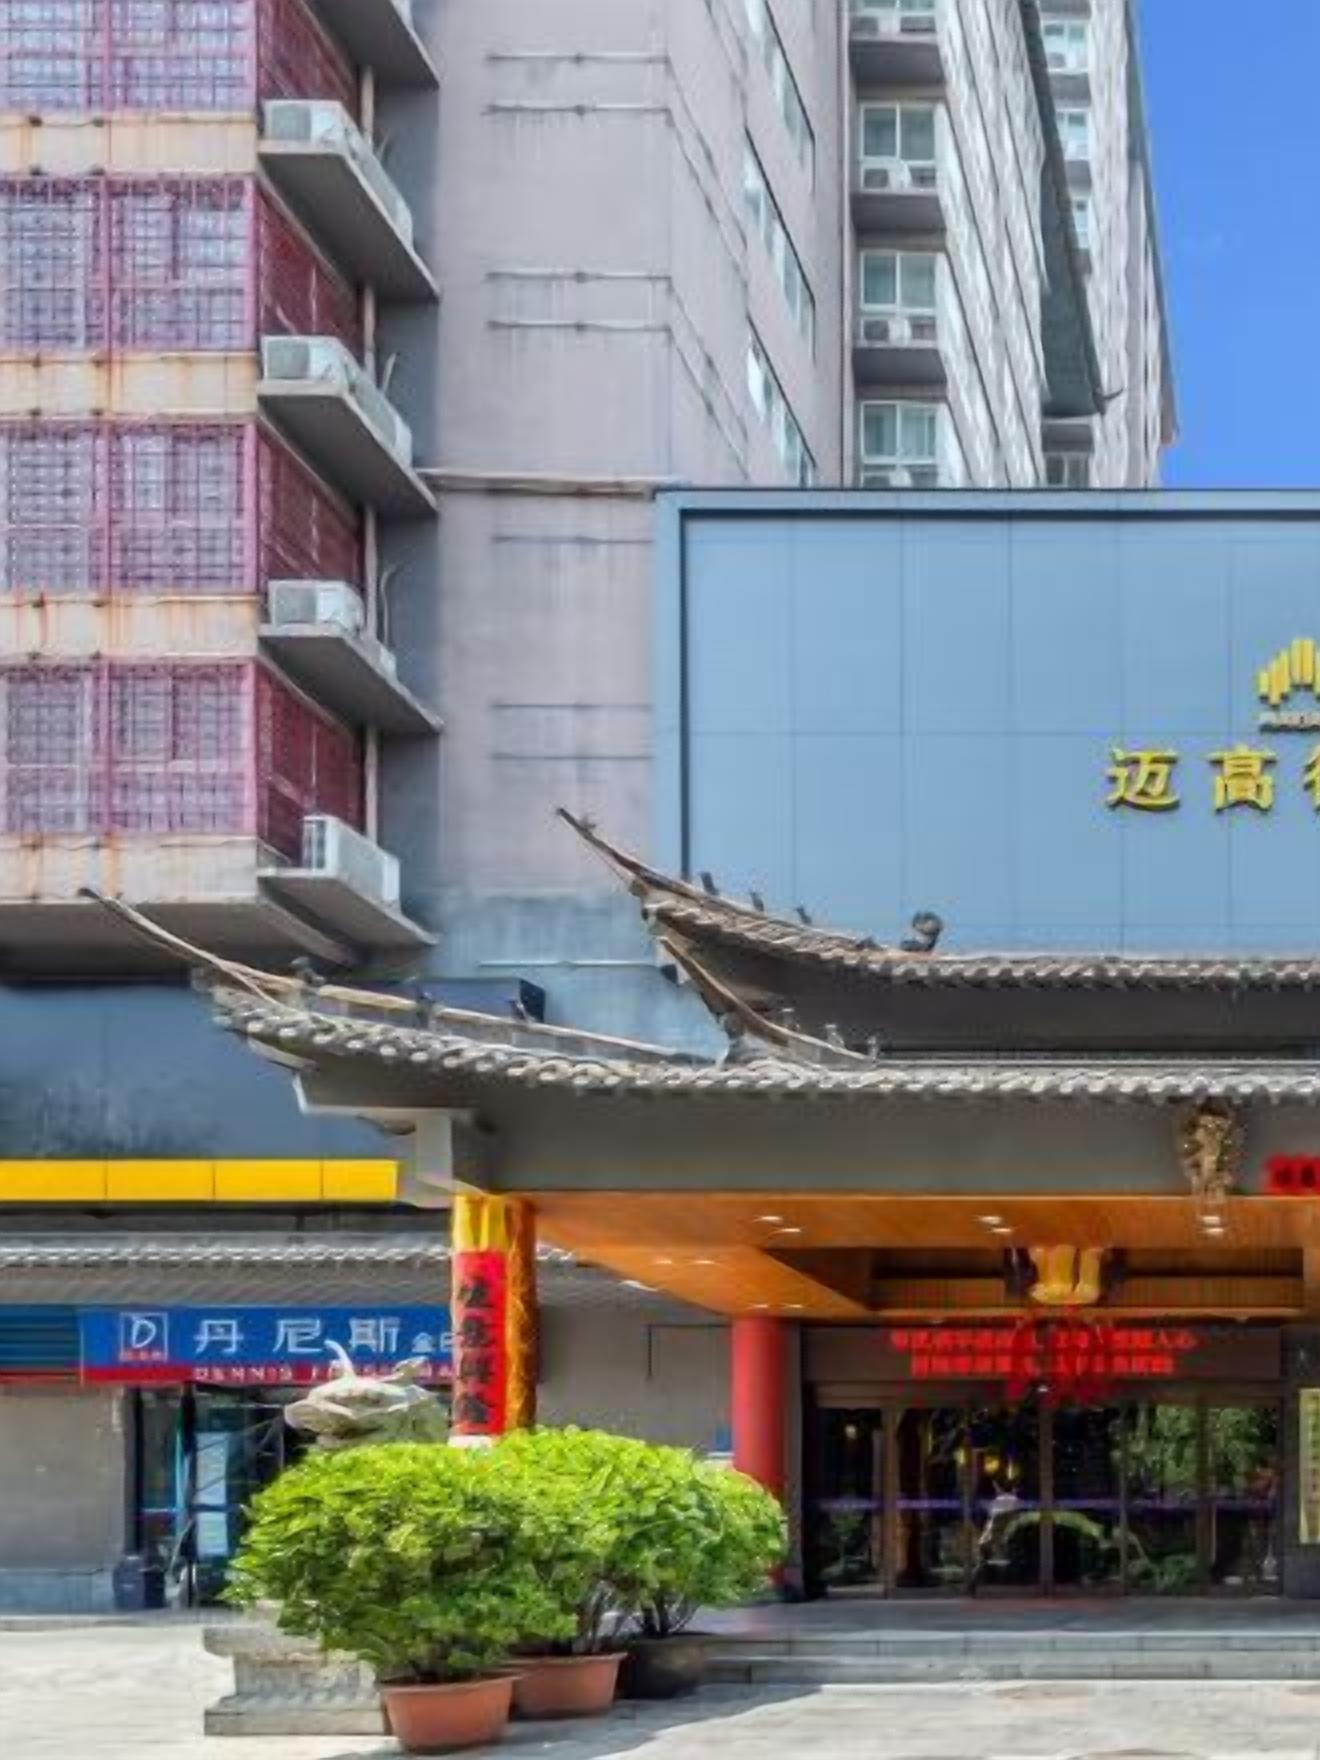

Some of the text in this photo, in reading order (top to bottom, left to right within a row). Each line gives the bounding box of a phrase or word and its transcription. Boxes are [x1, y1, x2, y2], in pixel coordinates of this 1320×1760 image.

[193, 1318, 401, 1353] 丹尼斯
[193, 1366, 293, 1382] DENNIS
